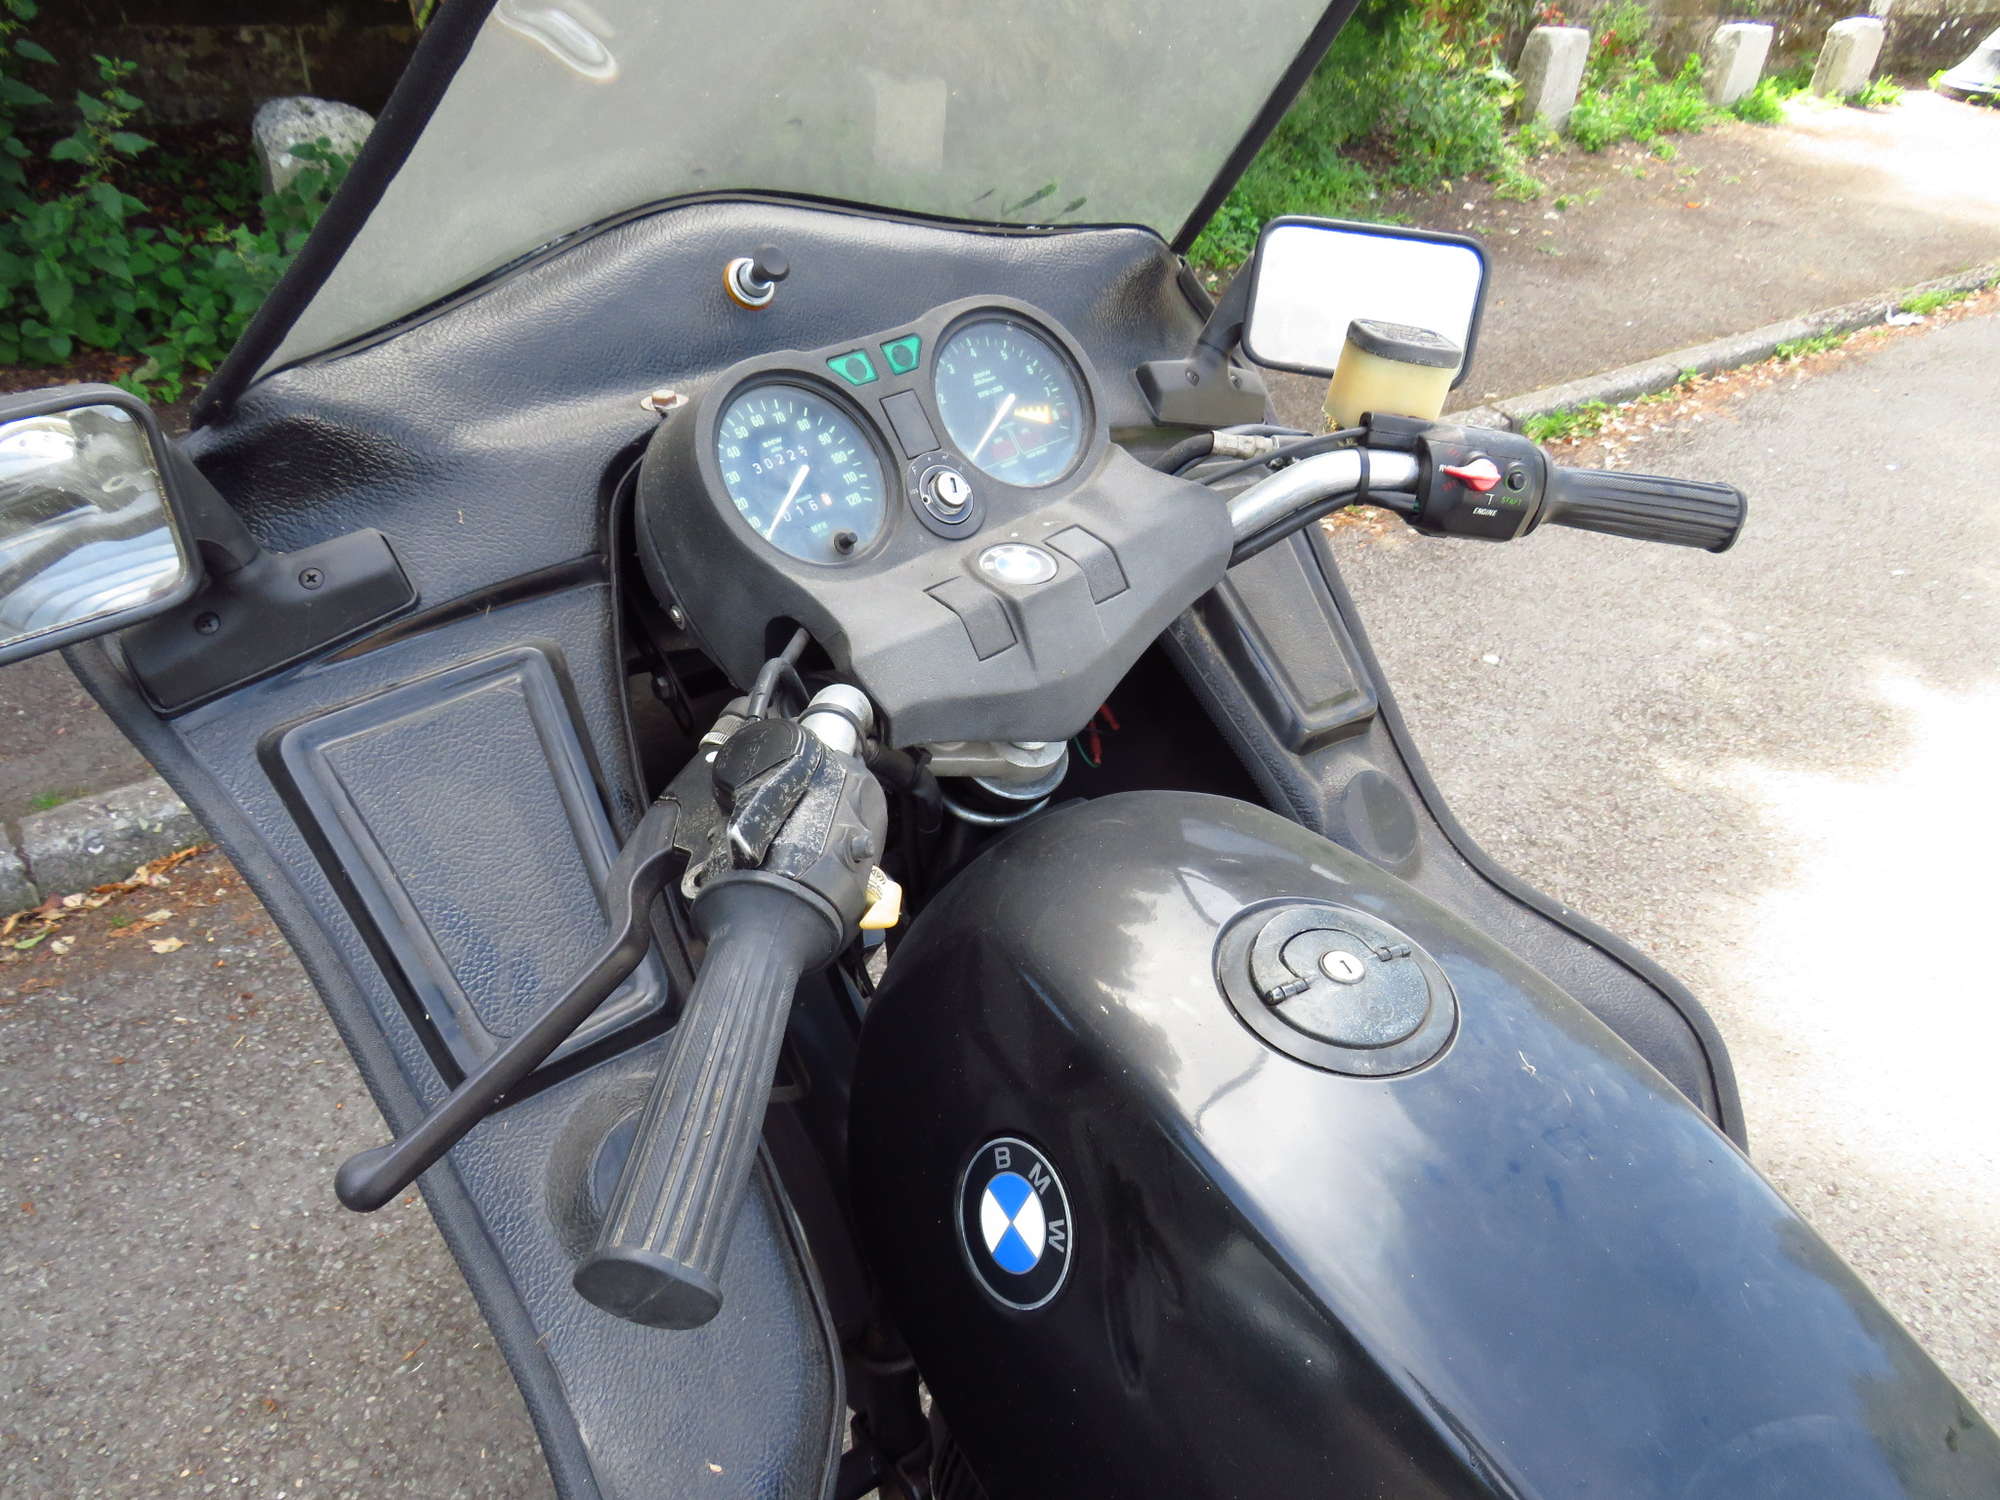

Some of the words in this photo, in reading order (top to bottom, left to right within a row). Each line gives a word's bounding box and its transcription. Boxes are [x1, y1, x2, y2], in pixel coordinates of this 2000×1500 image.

[1000, 349, 1008, 361] 5
[946, 363, 955, 375] 3
[1043, 386, 1051, 397] 7
[938, 393, 947, 405] 2
[750, 414, 765, 428] 60
[772, 411, 786, 425] 70
[796, 418, 811, 432] 80
[734, 426, 749, 439] 50
[818, 431, 832, 446] 90
[726, 446, 741, 459] 40
[830, 450, 848, 465] 100
[725, 470, 741, 485] 30
[842, 471, 858, 486] 110
[845, 492, 862, 507] 120
[1501, 495, 1522, 506] START
[1472, 507, 1498, 517] ENGINE
[993, 1146, 1067, 1254] BMW
